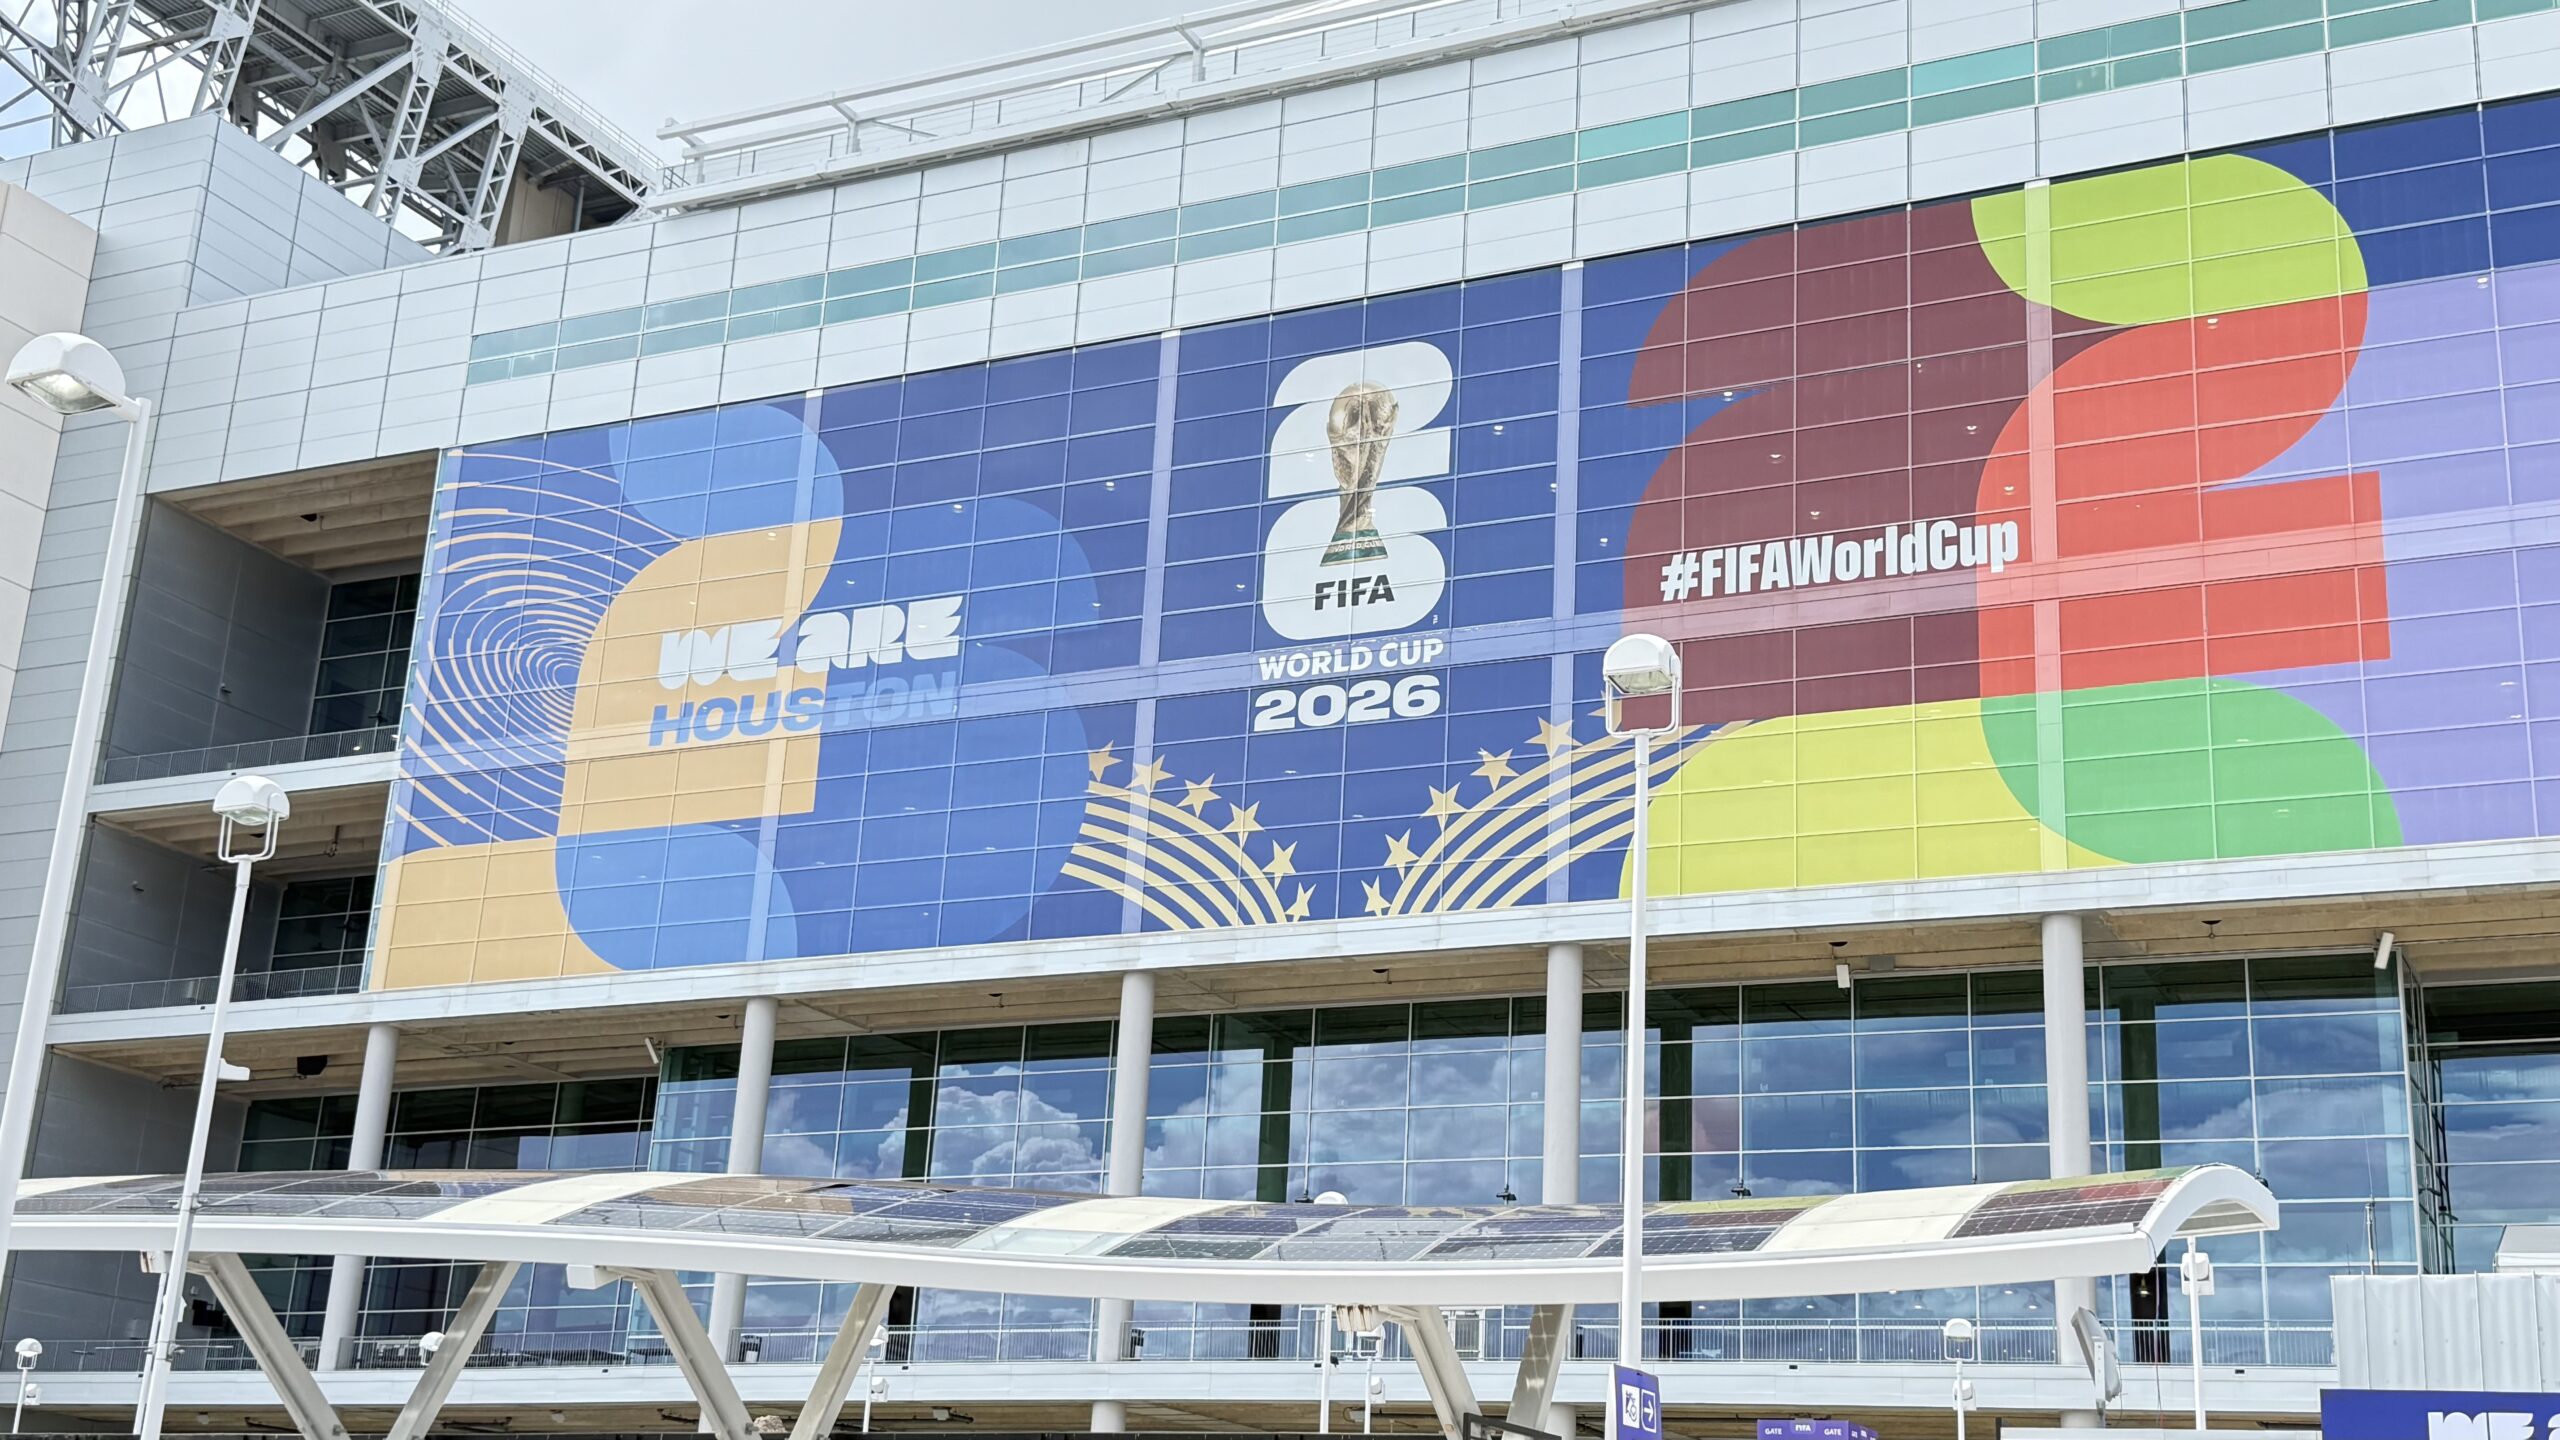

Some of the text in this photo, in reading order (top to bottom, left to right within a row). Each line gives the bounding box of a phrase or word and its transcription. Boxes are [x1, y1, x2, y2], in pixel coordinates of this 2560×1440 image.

[1315, 574, 1395, 610] FIFA
[1660, 520, 2019, 601] #FIFAWorldCup
[658, 595, 963, 690] WE ARE
[1259, 638, 1444, 681] WORLD CUP
[648, 671, 957, 747] HOUSTON
[1253, 674, 1441, 732] 2026
